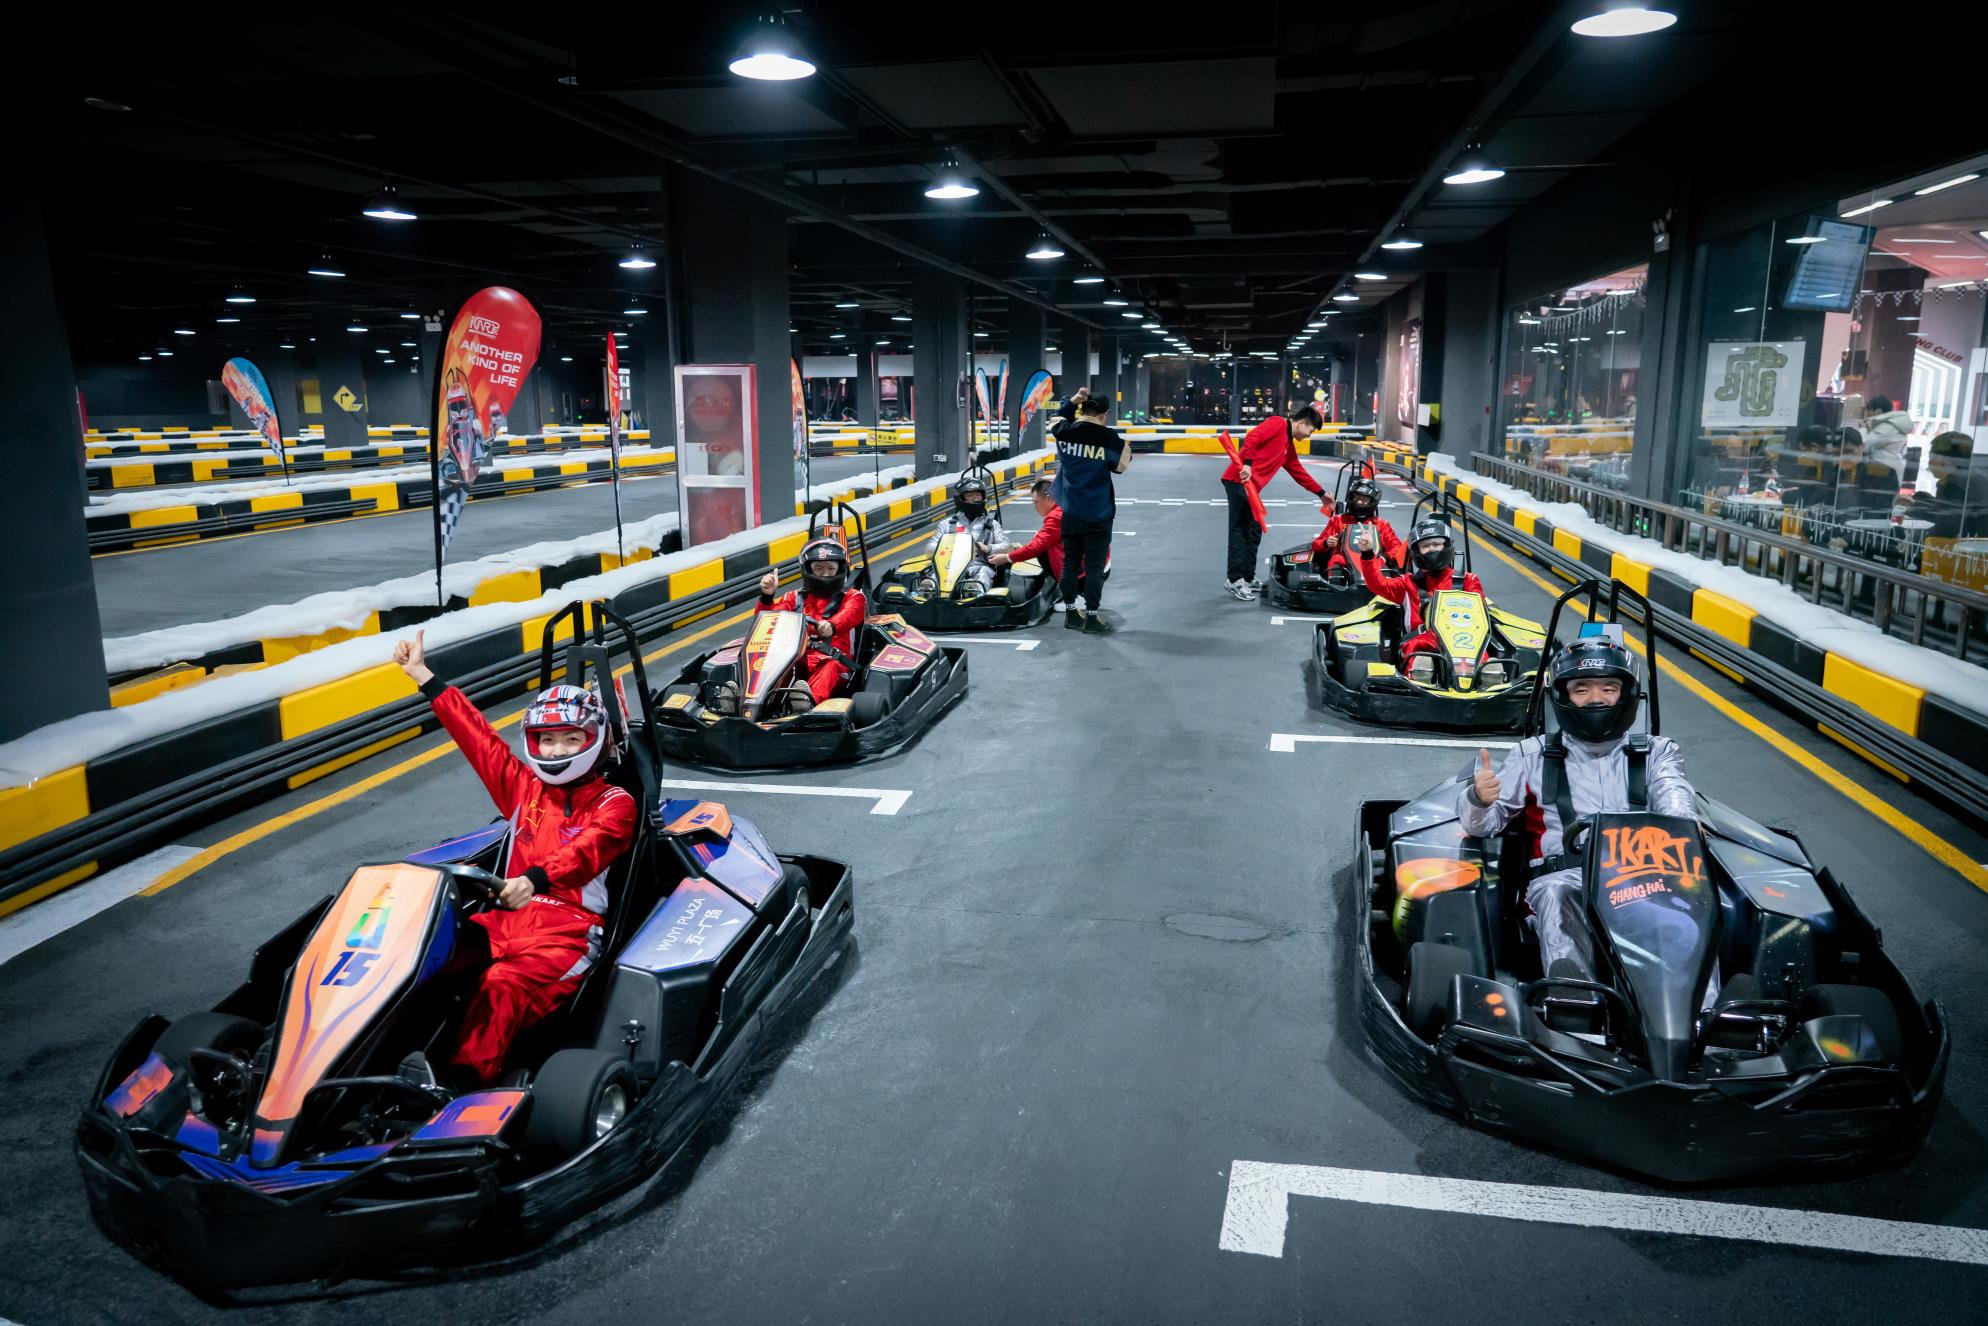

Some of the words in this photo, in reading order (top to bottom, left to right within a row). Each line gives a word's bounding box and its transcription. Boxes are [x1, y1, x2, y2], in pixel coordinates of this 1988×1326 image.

[460, 339, 523, 363] ANOTHER
[1933, 346, 1963, 363] CLUB
[467, 353, 498, 371] KIND
[501, 363, 521, 374] OF
[490, 373, 518, 388] LIFE
[1058, 440, 1105, 460] CHINA
[1453, 632, 1475, 650] 2
[656, 926, 684, 951] WUYI
[676, 898, 706, 926] PLAZA
[320, 951, 382, 987] 15
